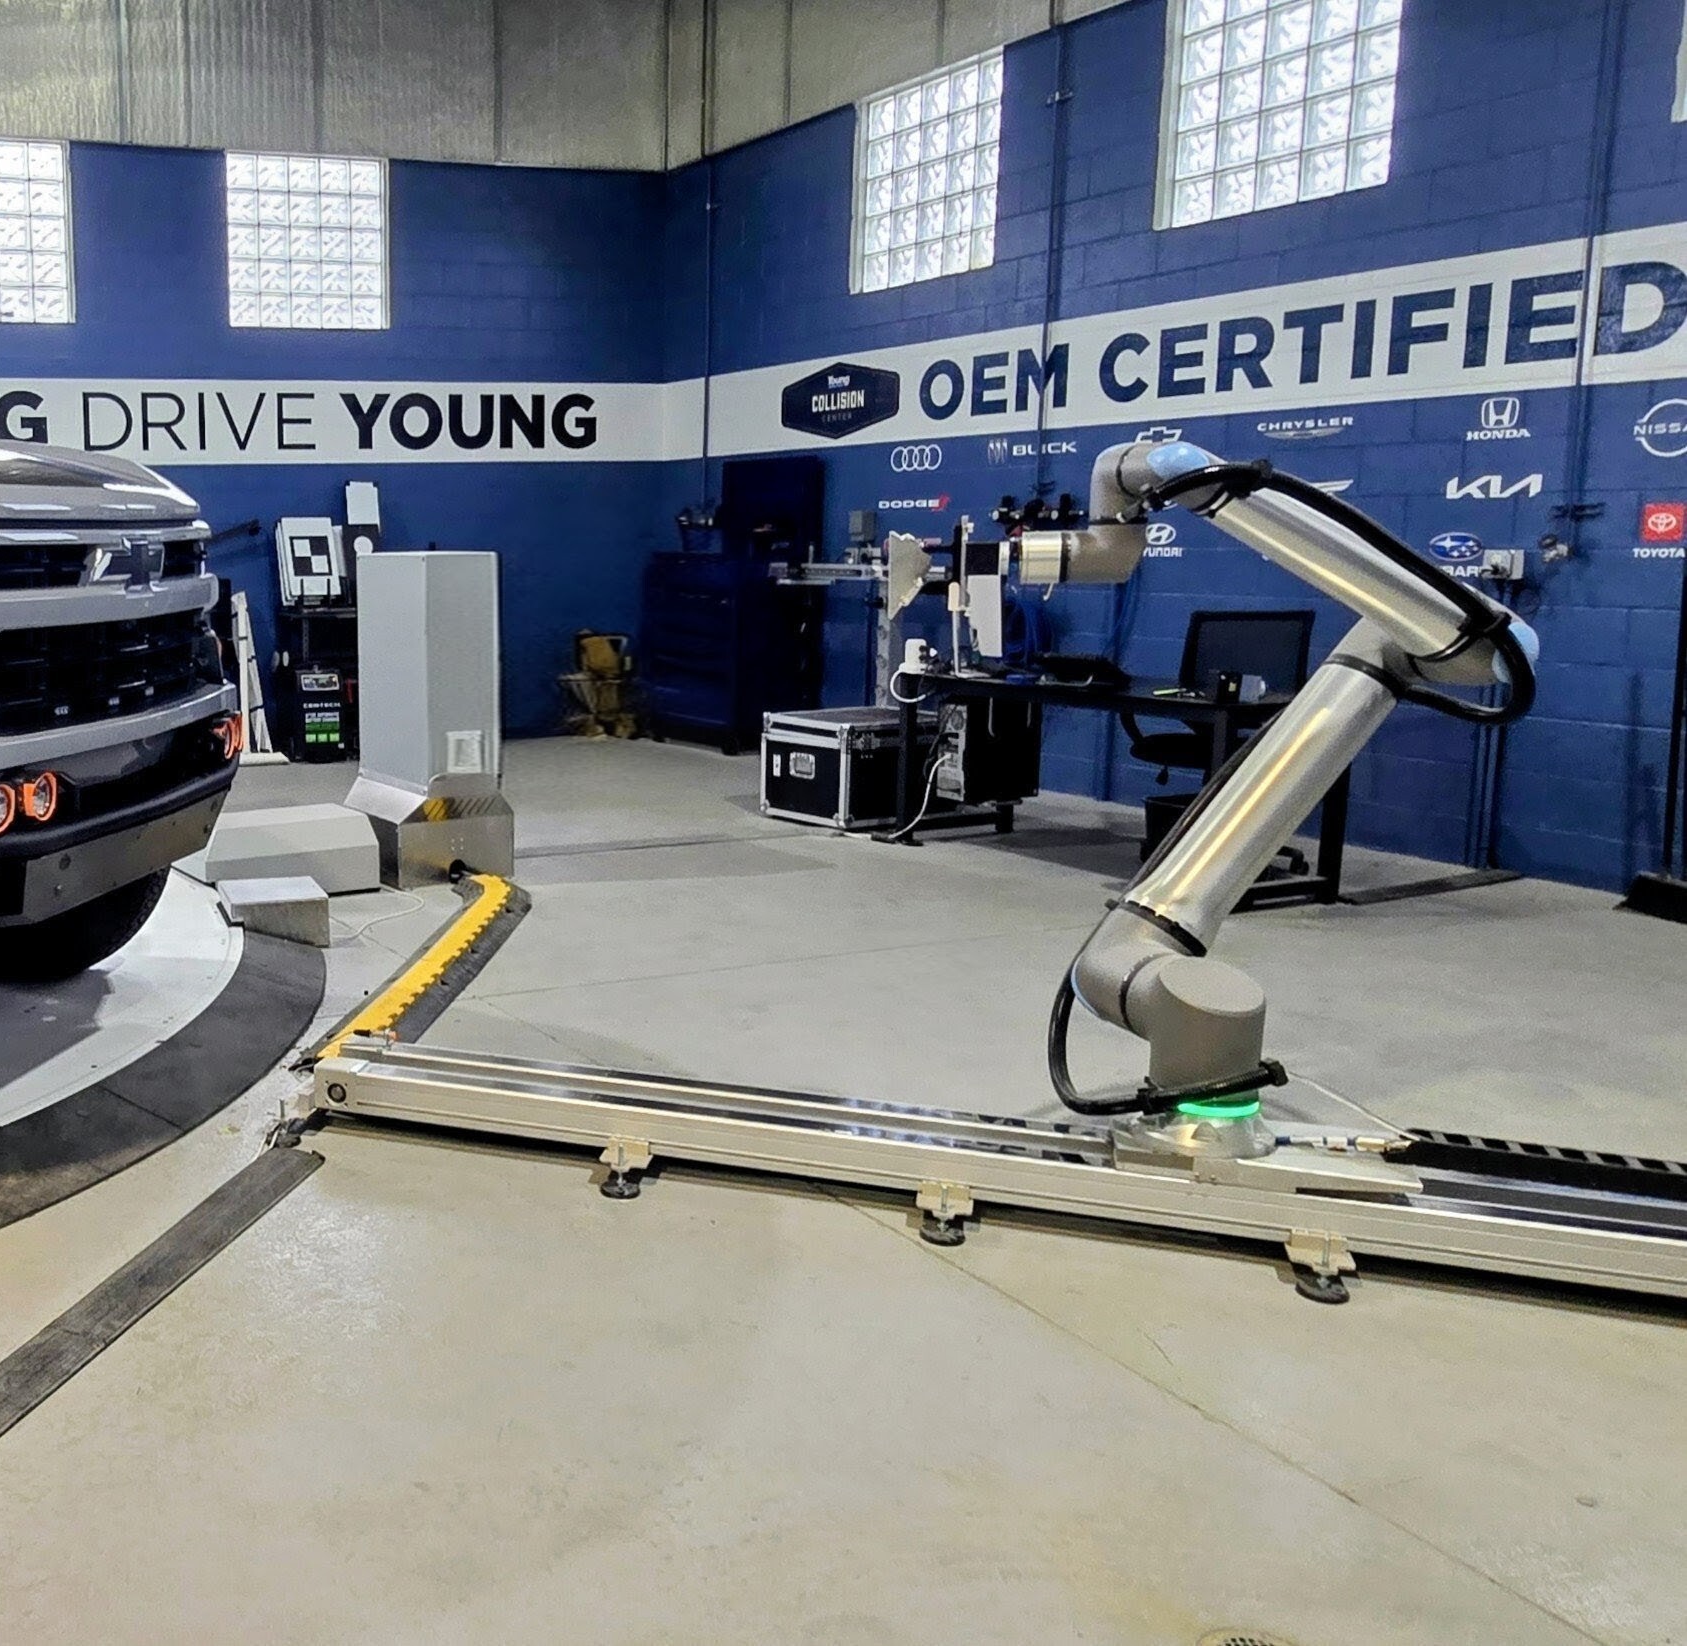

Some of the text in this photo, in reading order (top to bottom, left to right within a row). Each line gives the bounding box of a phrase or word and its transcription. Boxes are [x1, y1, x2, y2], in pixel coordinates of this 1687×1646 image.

[920, 260, 1687, 421] OEM CERTIFIED
[812, 390, 865, 413] COLLISION
[82, 392, 316, 452] DRIVE
[338, 392, 598, 450] YOUNG
[1256, 416, 1354, 431] CHRYSLER
[1466, 428, 1531, 441] HONDA
[878, 499, 940, 509] DODGE
[1633, 547, 1687, 559] TOYOTA
